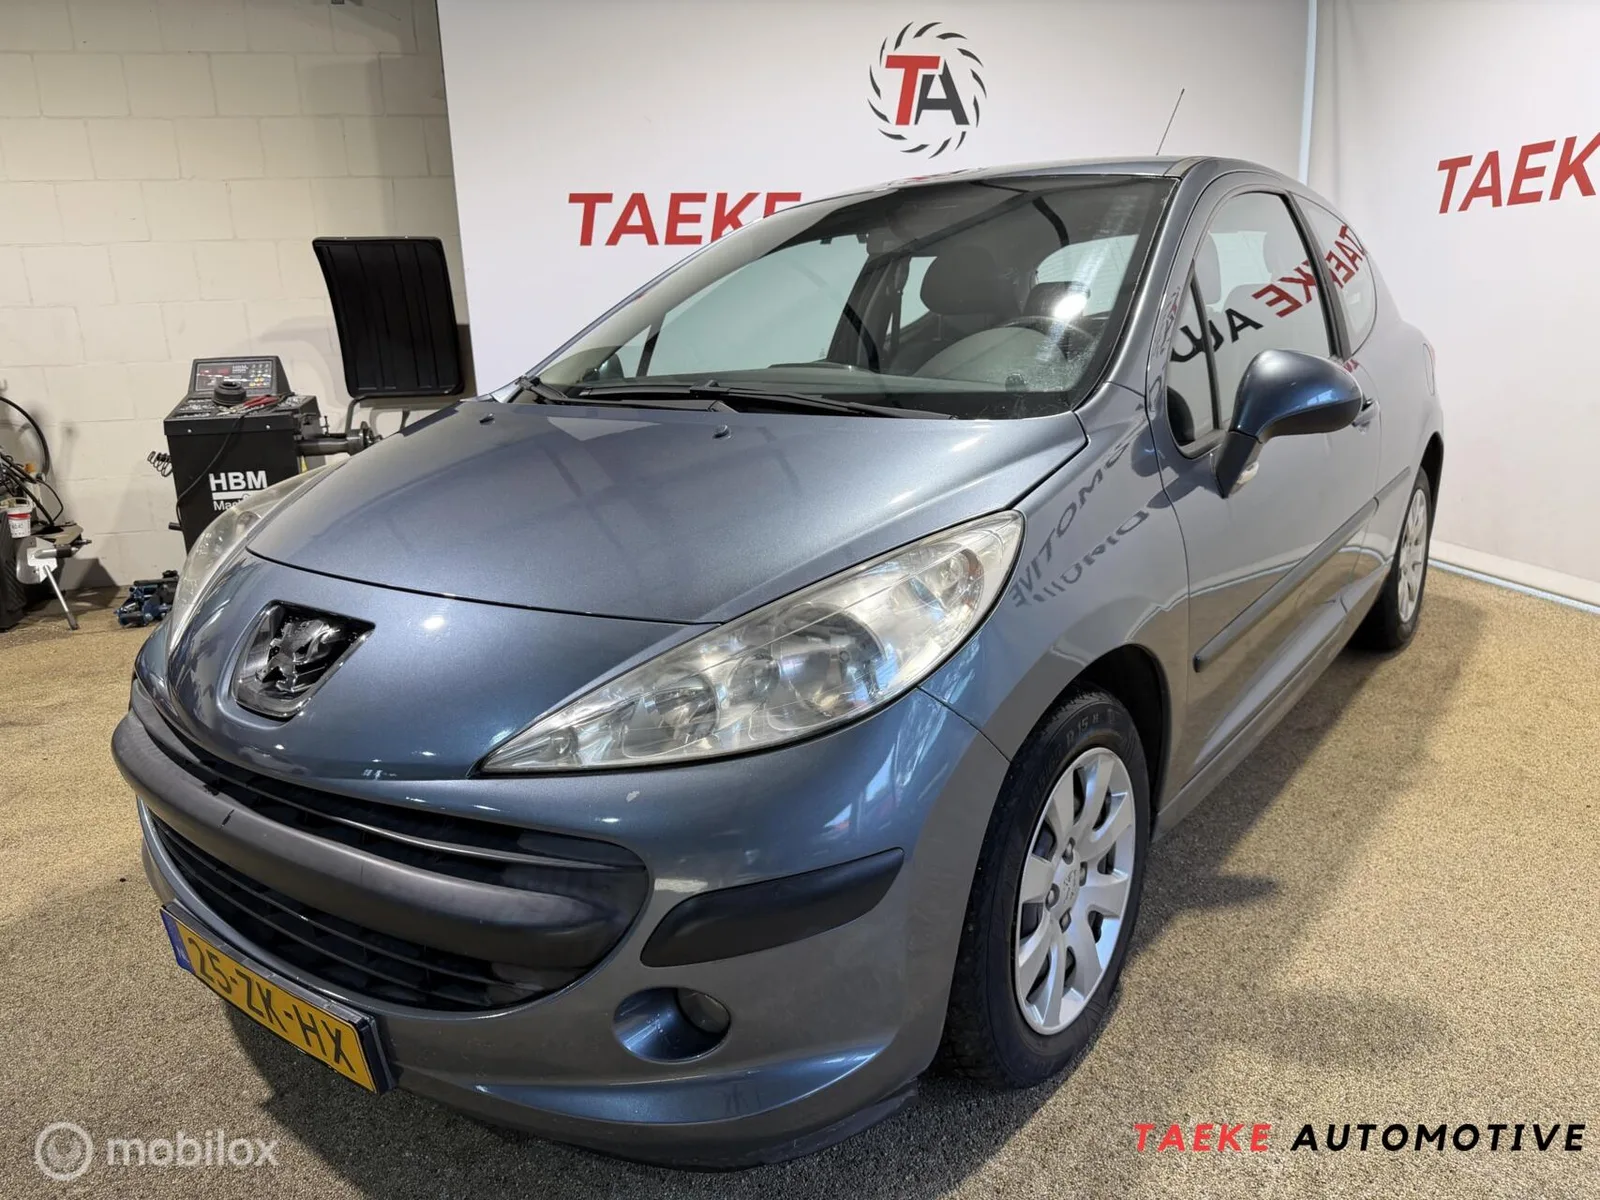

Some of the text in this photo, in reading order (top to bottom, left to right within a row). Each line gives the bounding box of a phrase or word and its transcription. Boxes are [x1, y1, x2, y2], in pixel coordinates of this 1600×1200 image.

[885, 54, 970, 126] TA
[208, 470, 268, 492] HBM
[187, 936, 356, 1074] 25-ZK-HX
